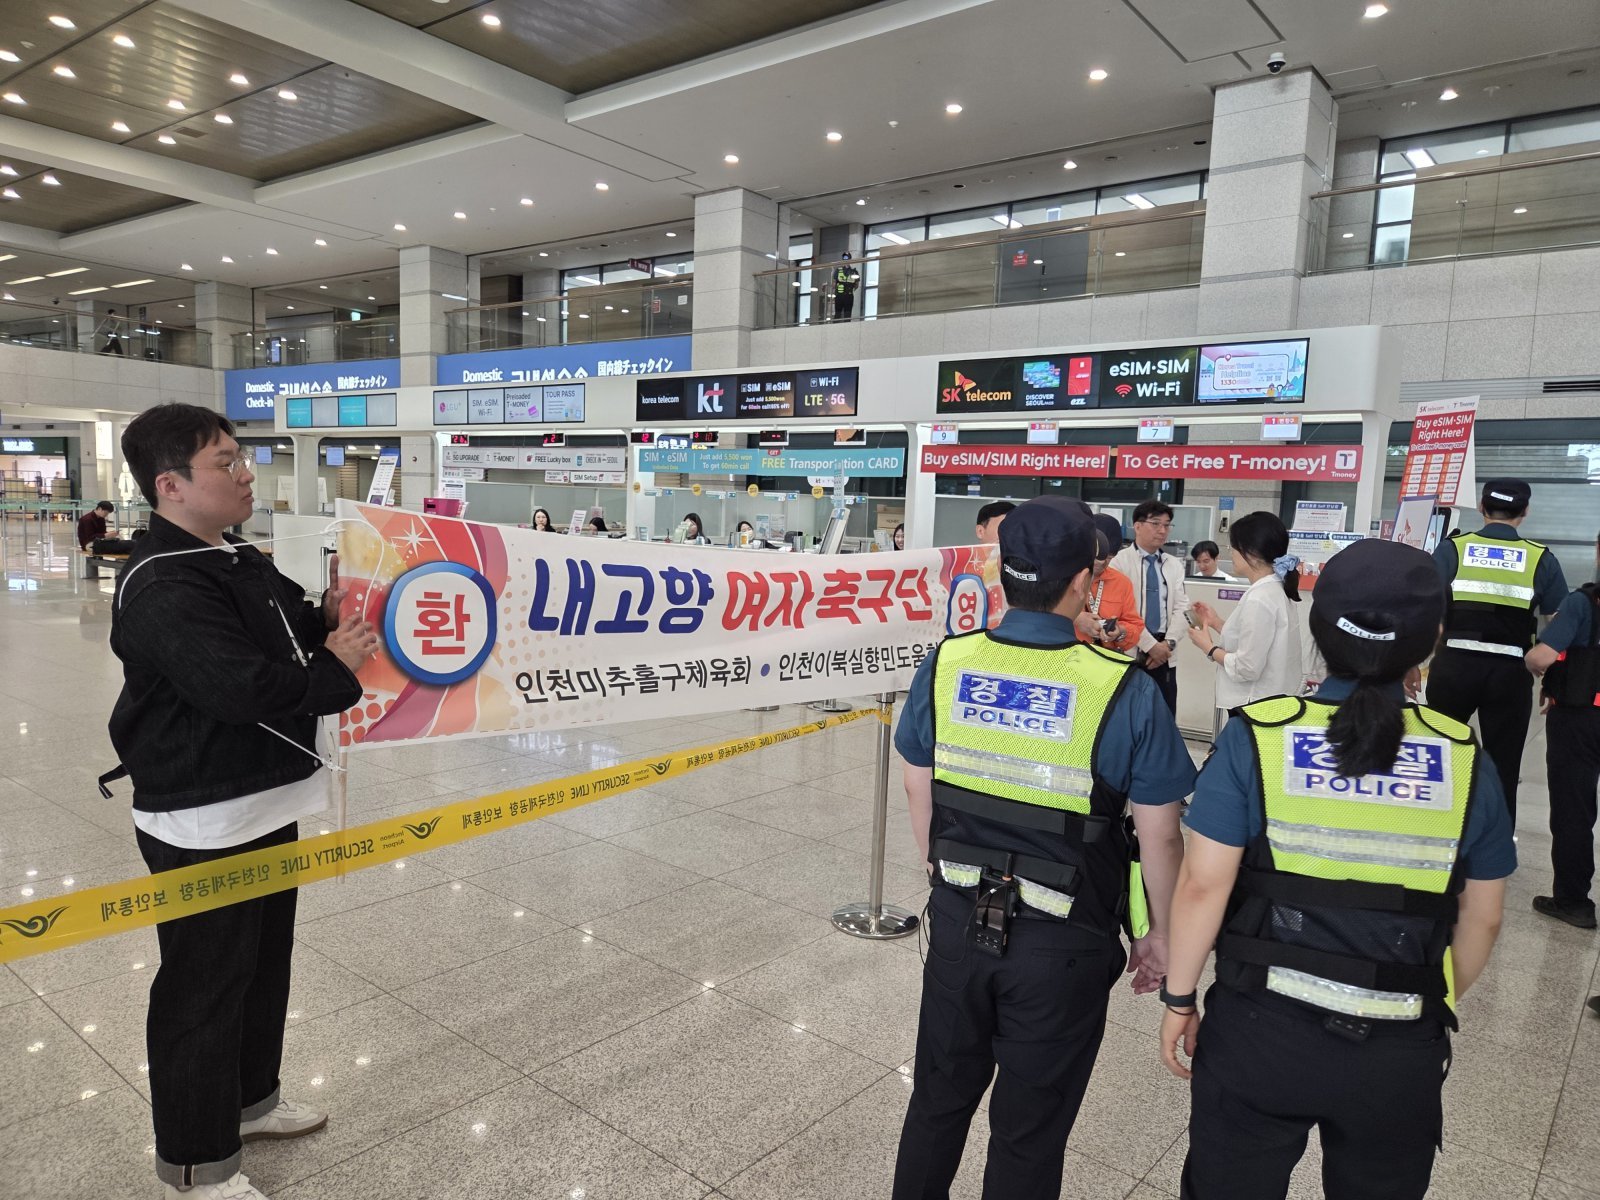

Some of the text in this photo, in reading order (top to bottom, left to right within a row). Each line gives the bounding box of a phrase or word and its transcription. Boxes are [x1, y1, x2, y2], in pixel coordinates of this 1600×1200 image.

[463, 368, 504, 383] Domestic
[819, 376, 839, 386] Wi-Fi
[245, 381, 275, 393] Domestic
[747, 382, 791, 392] SIM eSIM
[1136, 380, 1181, 397] Wi-Fi
[561, 390, 576, 398] PASS
[642, 396, 657, 404] korea
[697, 383, 724, 413] kt
[804, 394, 846, 406] LTE 5G
[942, 388, 1012, 402] SK telecom
[246, 396, 274, 408] Check-in
[506, 400, 530, 408] T-MONEY
[1419, 405, 1427, 413] SK
[1416, 420, 1431, 430] Buy
[941, 432, 946, 440] 9
[1152, 429, 1158, 438] 7
[1418, 428, 1464, 442] Right Here!
[535, 455, 571, 465] FREE Lucky box
[644, 452, 688, 462] SIM eSIM
[924, 452, 1106, 470] Buy eSIM/SIM Right Here!
[762, 457, 898, 472] FREE Transportion CARD
[1122, 454, 1326, 474] To Get Free T-money!
[1471, 559, 1517, 569] POLICE
[528, 558, 714, 636] 내고향
[958, 592, 977, 630] 영
[413, 591, 471, 656] 환
[515, 656, 752, 704] 인천미추홀구체육회
[963, 706, 1056, 734] POLICE
[1306, 774, 1432, 801] POLICE
